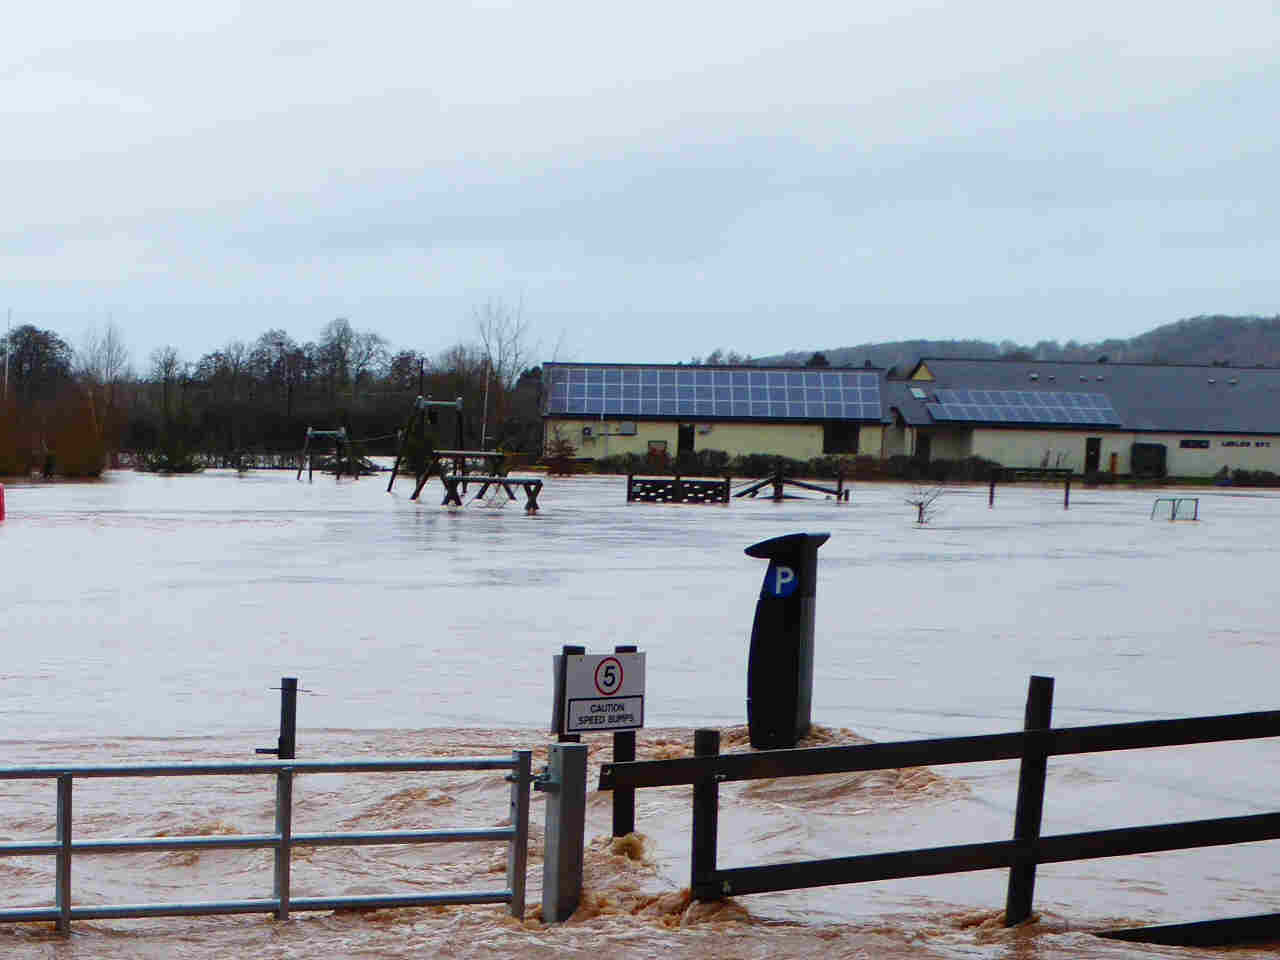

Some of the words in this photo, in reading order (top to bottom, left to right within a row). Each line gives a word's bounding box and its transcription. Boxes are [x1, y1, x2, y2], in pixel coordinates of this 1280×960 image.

[776, 567, 794, 594] P
[603, 665, 616, 687] 5
[590, 703, 625, 713] CAUTION
[578, 714, 606, 725] SPEED
